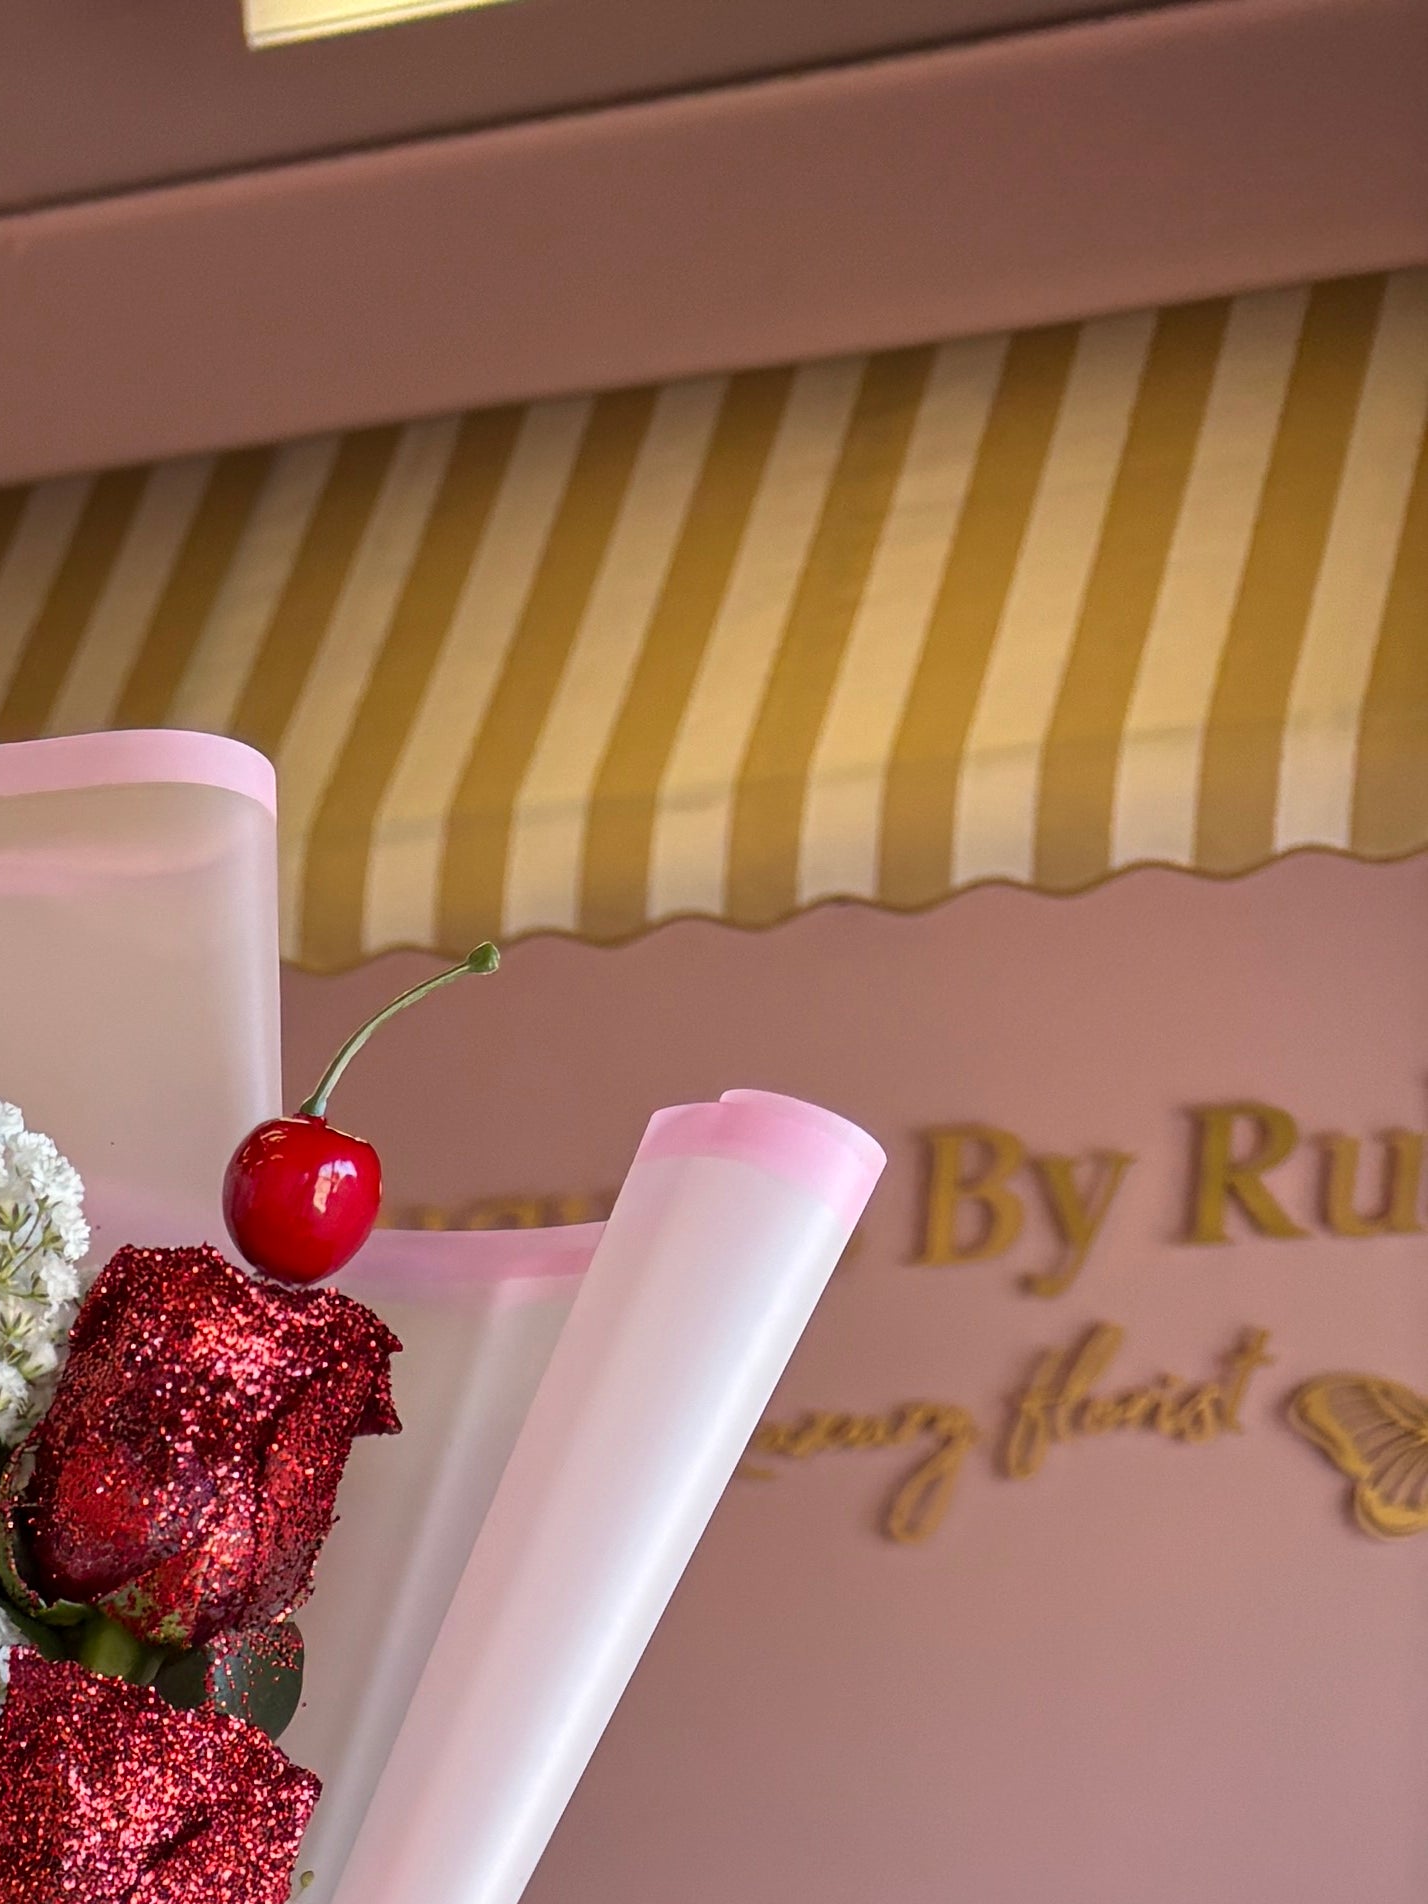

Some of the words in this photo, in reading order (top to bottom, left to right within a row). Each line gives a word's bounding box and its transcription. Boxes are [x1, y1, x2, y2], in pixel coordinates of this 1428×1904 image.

[912, 1120, 1138, 1298] By
[1180, 1098, 1428, 1246] Ru
[736, 1400, 980, 1545] uxury
[996, 1322, 1274, 1480] florist
